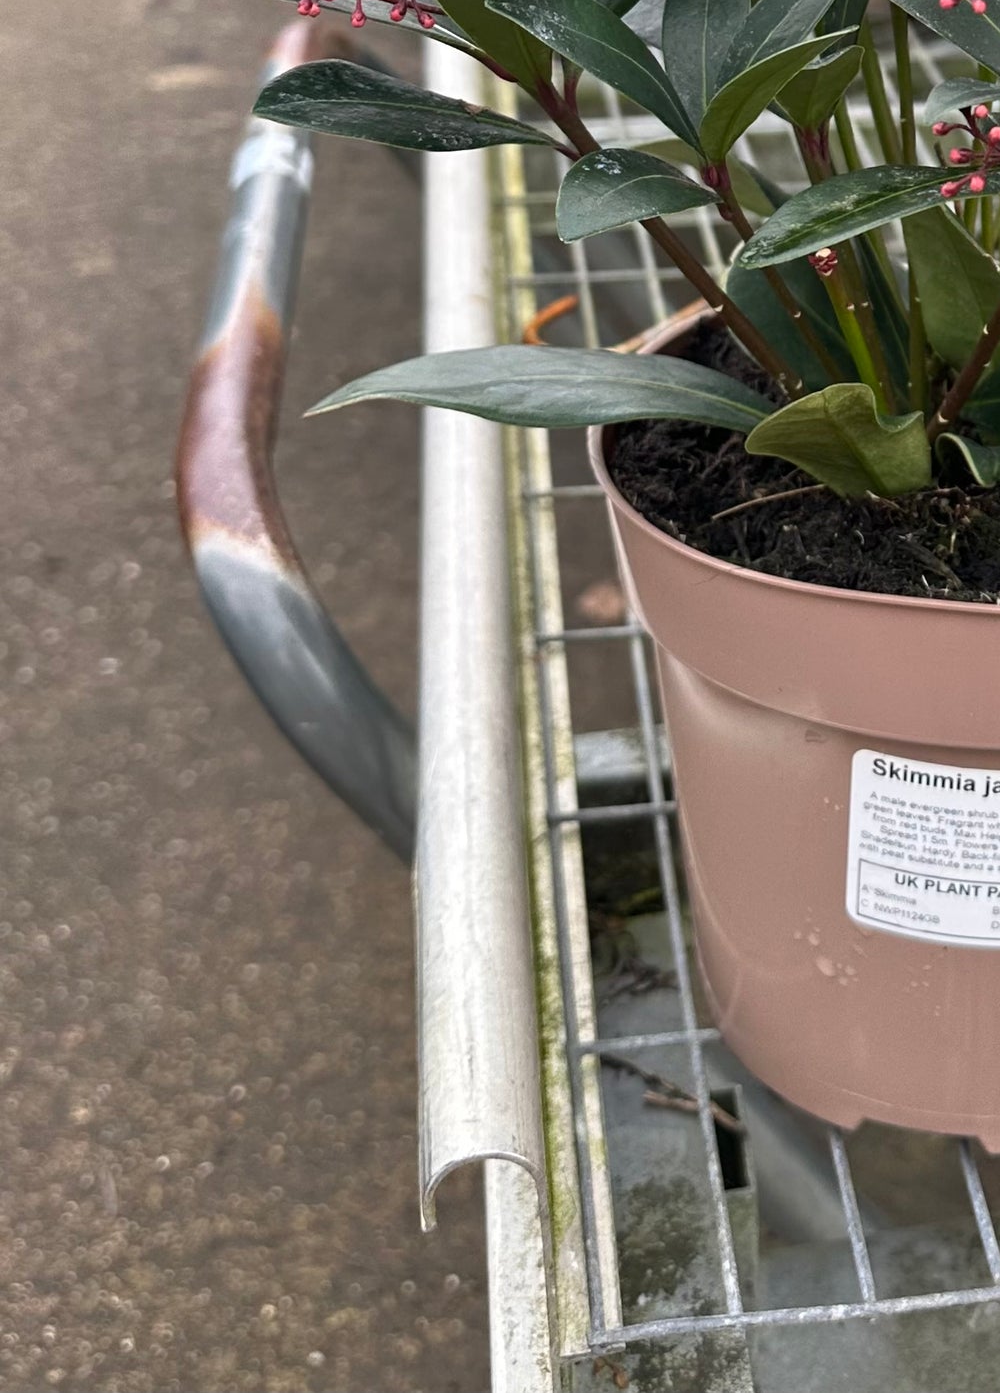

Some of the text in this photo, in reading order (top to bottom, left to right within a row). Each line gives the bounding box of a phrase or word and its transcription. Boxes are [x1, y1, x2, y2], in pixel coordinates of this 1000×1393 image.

[872, 758, 976, 791] Skimmia
[863, 800, 894, 815] green
[937, 815, 984, 829] Fragrant
[870, 791, 879, 800] A
[881, 794, 907, 807] male
[909, 798, 965, 815] evergreen
[967, 809, 999, 819] shrub
[872, 812, 896, 826] from
[899, 820, 917, 830] red
[879, 824, 918, 841] Spread
[955, 838, 999, 851] Flowers
[881, 847, 905, 859] peat
[907, 853, 961, 869] substitute
[963, 862, 984, 872] and
[894, 872, 919, 889] UK
[924, 878, 983, 898] PLANT
